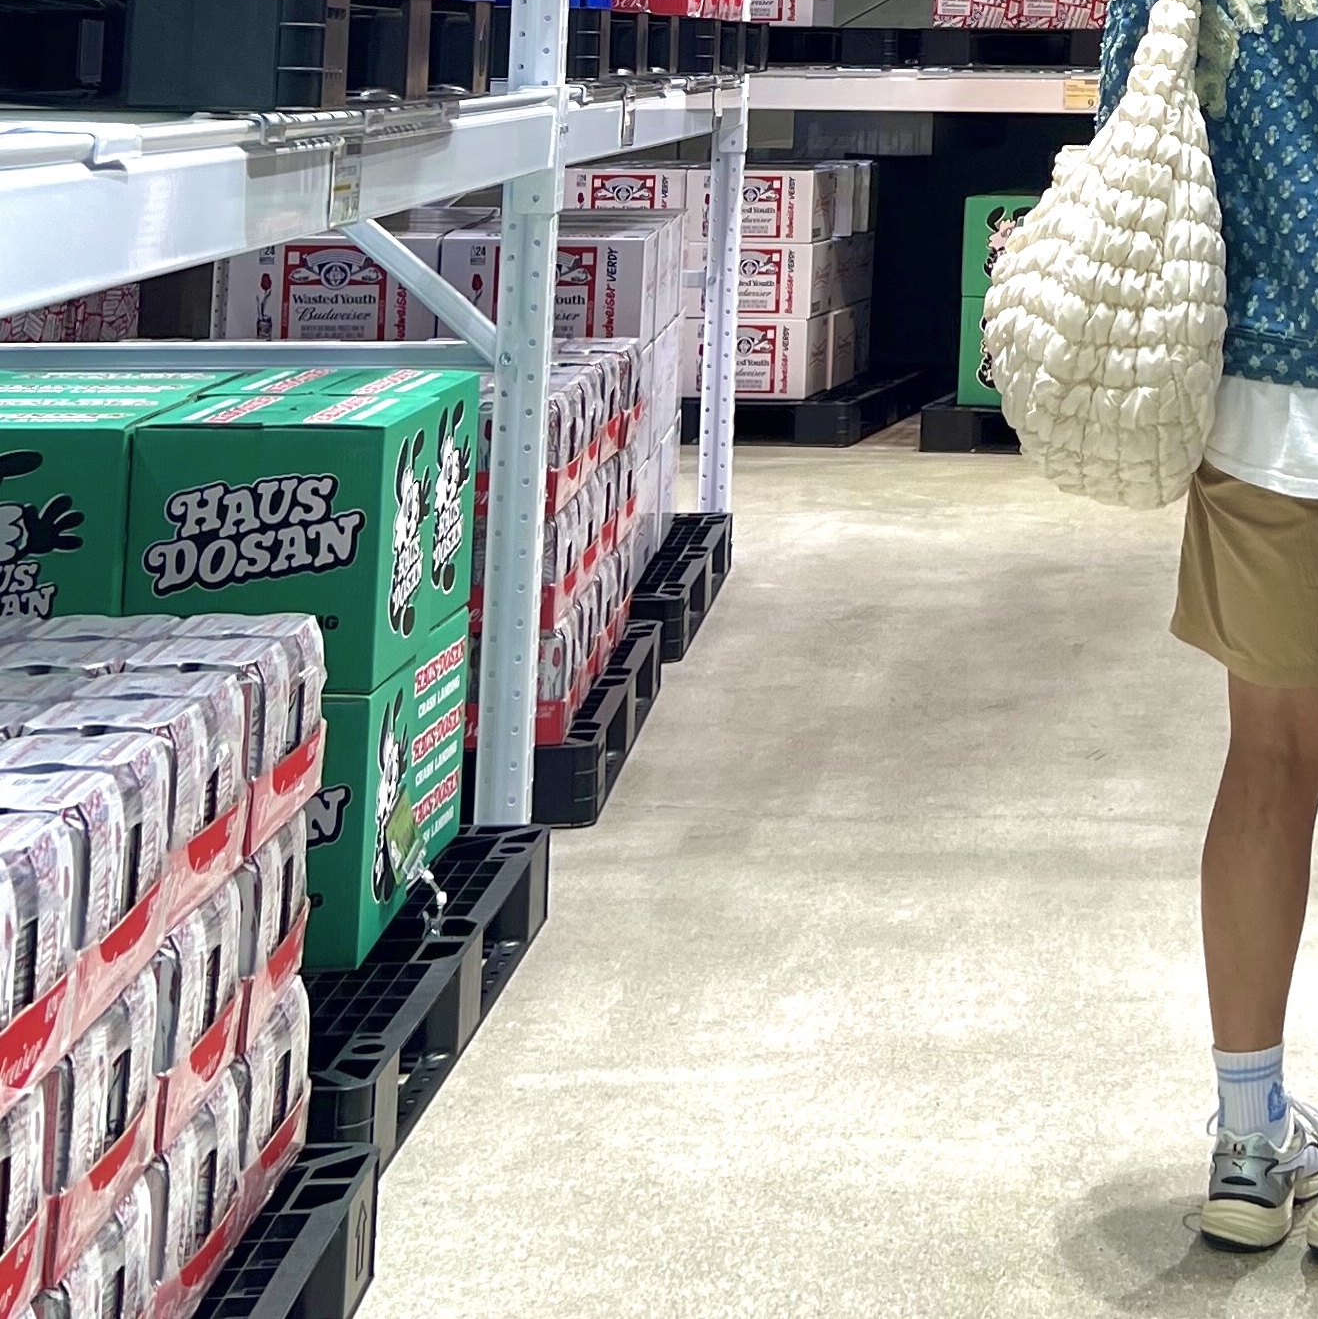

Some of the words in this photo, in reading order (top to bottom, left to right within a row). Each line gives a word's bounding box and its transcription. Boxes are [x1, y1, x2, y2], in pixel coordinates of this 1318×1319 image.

[475, 246, 486, 257] 24
[606, 247, 619, 282] VERDY
[292, 293, 336, 305] Wasted
[339, 293, 377, 305] Youth
[295, 305, 371, 322] Budweiser
[170, 477, 334, 539] HAUS
[147, 514, 363, 591] DOSAN
